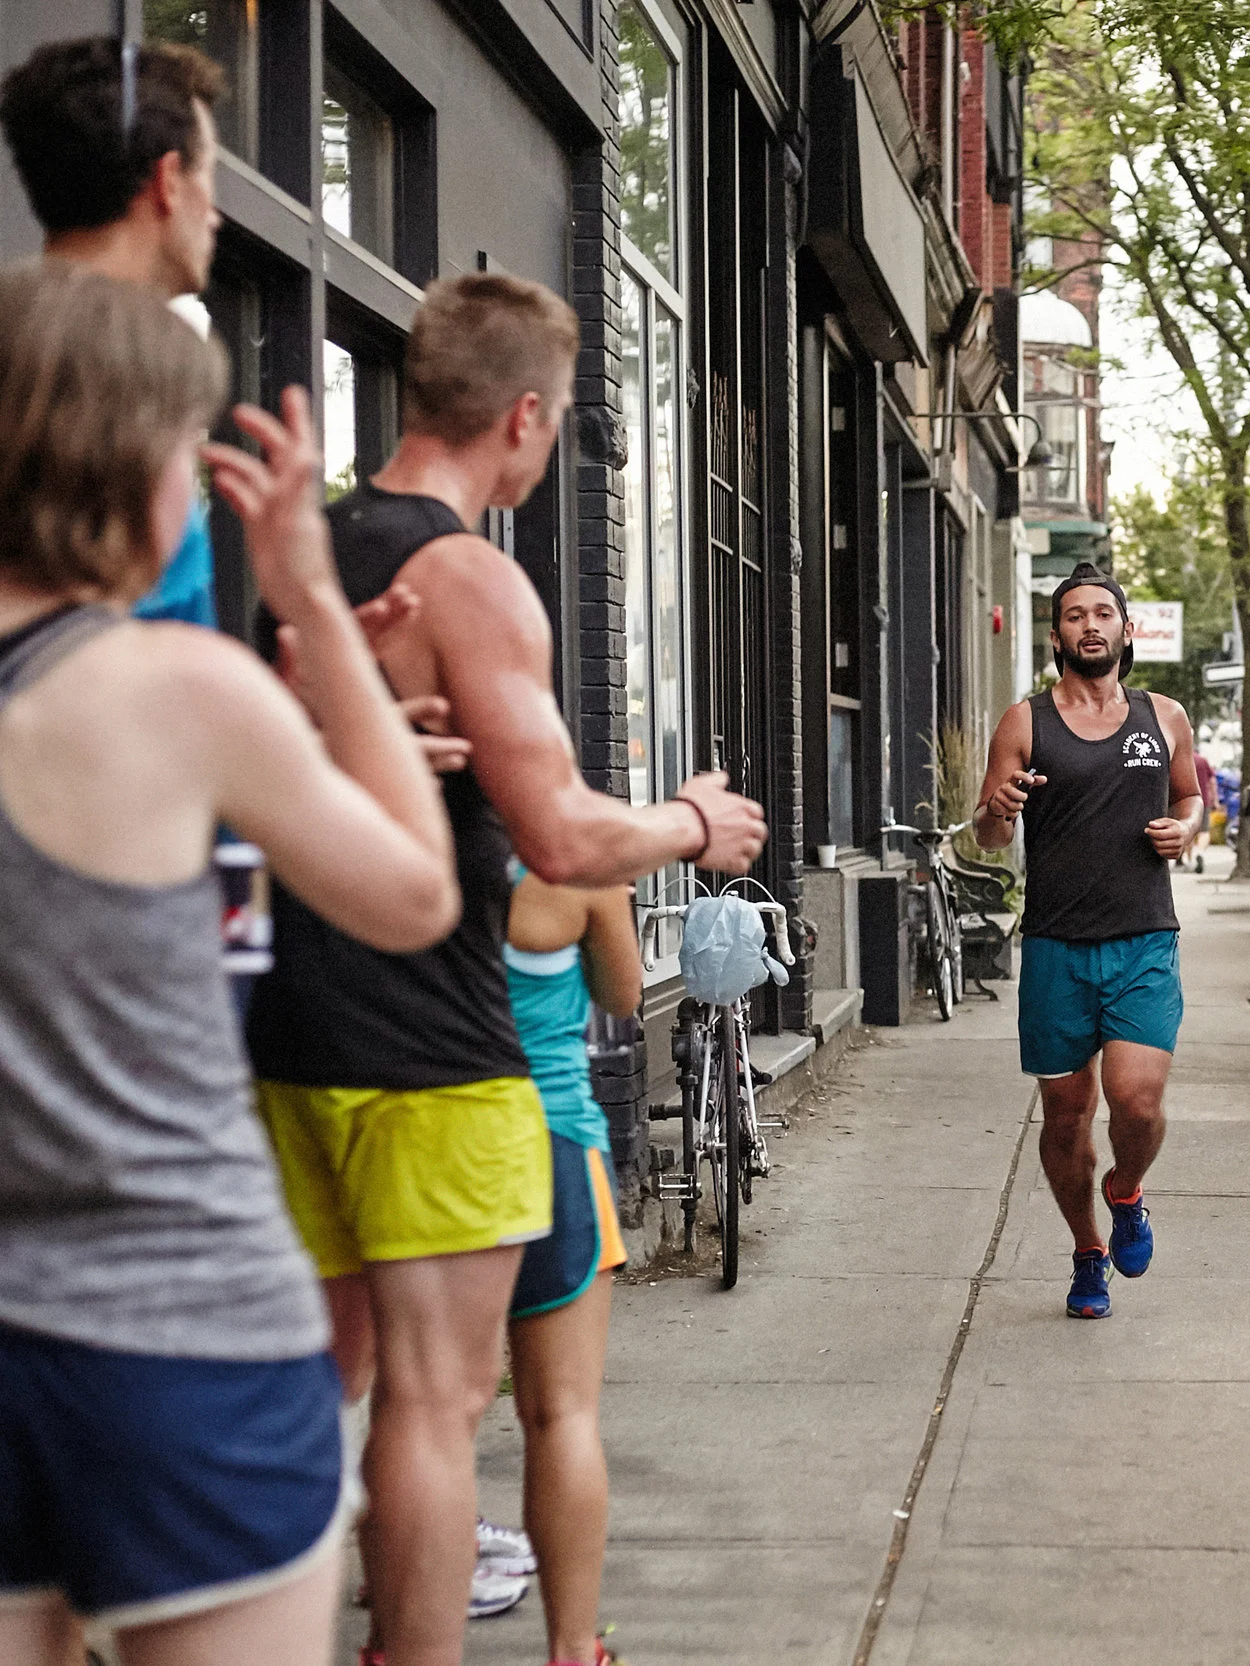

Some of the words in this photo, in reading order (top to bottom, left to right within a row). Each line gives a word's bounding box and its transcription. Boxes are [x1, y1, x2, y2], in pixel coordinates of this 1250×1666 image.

[1140, 732, 1149, 740] OF
[1127, 758, 1141, 767] RUN
[1141, 758, 1159, 767] CREW
